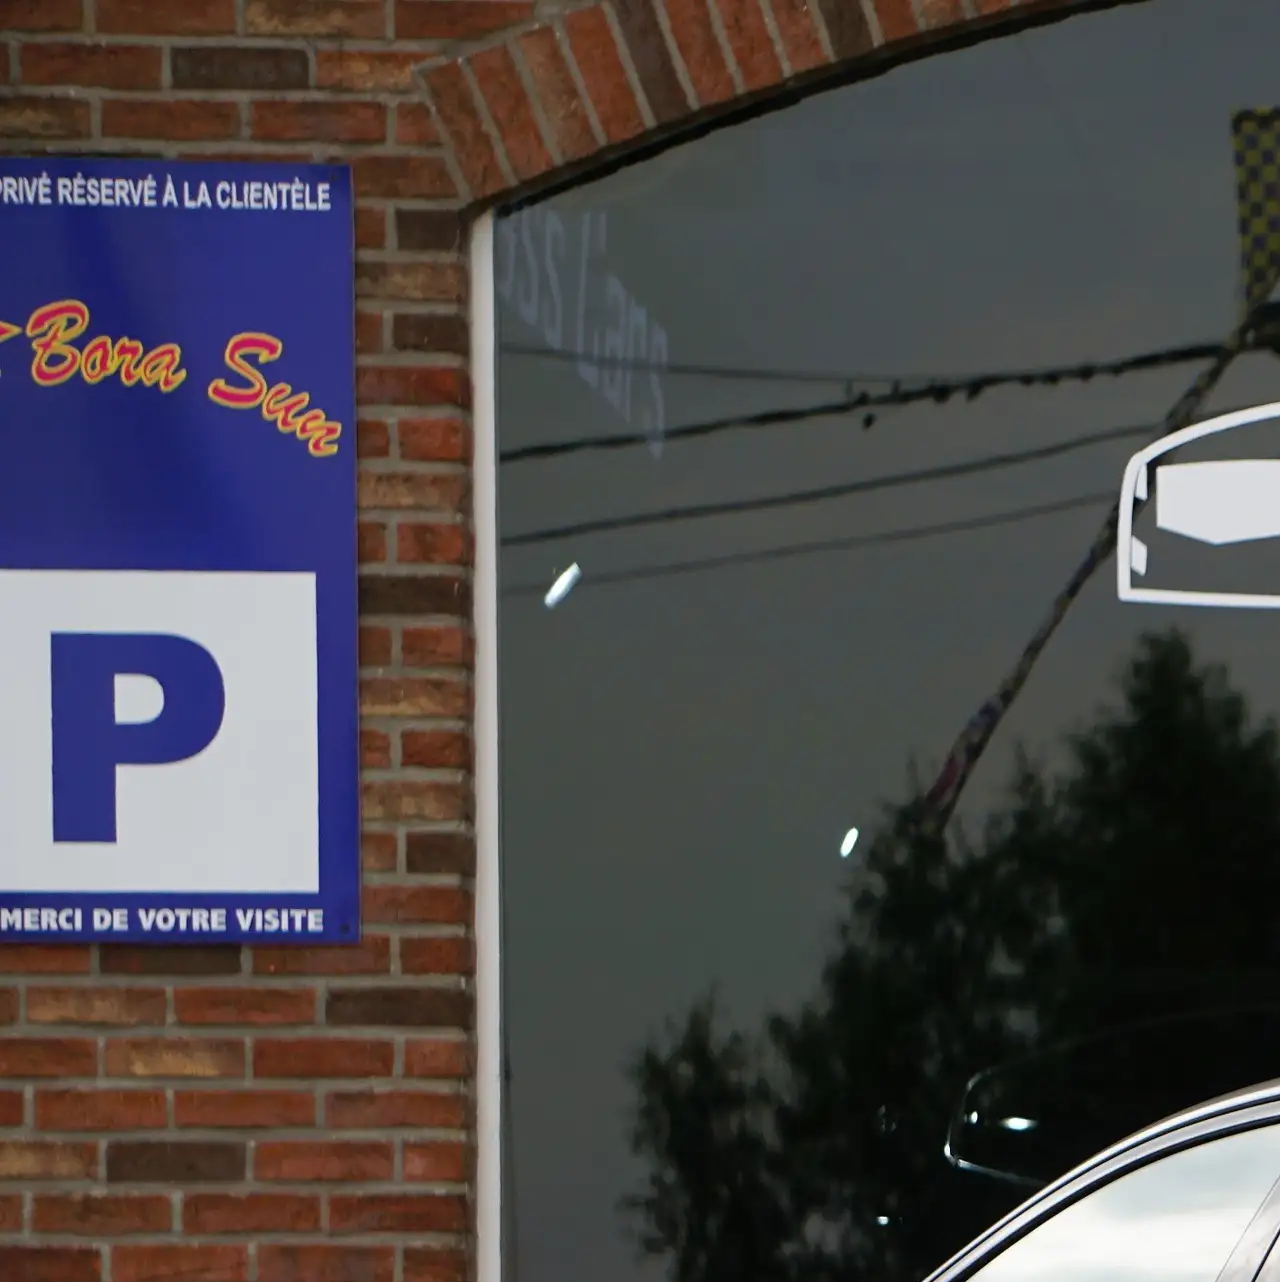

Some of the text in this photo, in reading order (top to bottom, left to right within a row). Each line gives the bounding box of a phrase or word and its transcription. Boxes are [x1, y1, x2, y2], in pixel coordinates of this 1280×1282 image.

[0, 171, 331, 211] RIVÉ RÉSERVÉ À LA CLIENTÈLE
[26, 299, 187, 392] Bora
[208, 332, 342, 457] Sun
[51, 632, 226, 843] P
[0, 908, 323, 932] MERCI DE VOTRE VISITE
